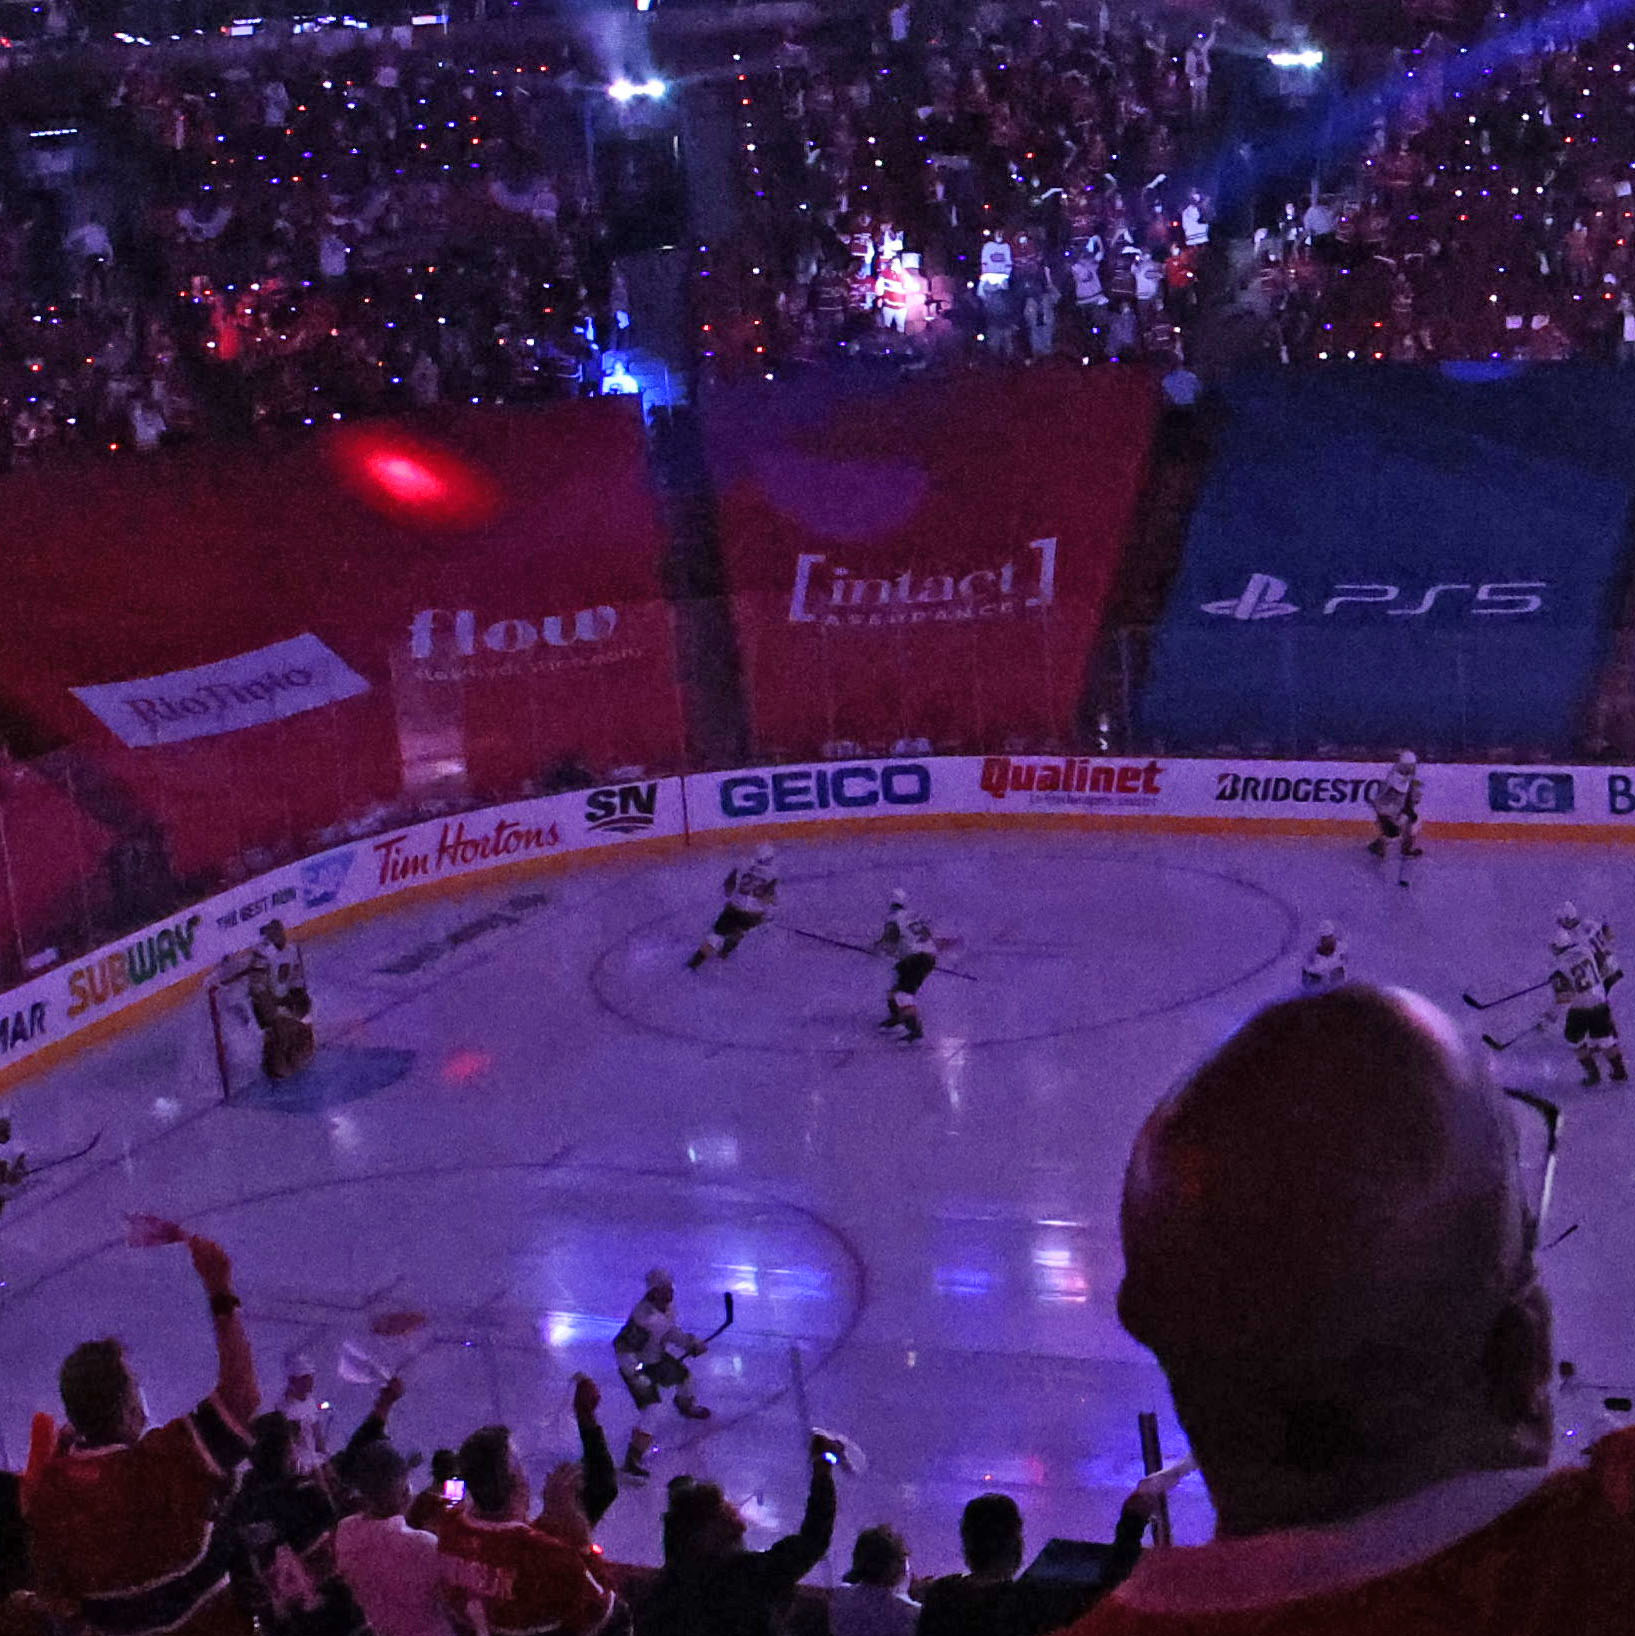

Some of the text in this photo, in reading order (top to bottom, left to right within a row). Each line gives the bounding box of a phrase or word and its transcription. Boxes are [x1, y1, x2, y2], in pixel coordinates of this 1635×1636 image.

[1322, 582, 1547, 615] PS5
[719, 764, 932, 818] GEICO
[980, 757, 1167, 799] Qualinet
[1216, 773, 1384, 804] BRIDGESTO
[374, 835, 429, 885] Tim
[435, 820, 560, 870] Hortons
[67, 915, 204, 1019] SUBWAY
